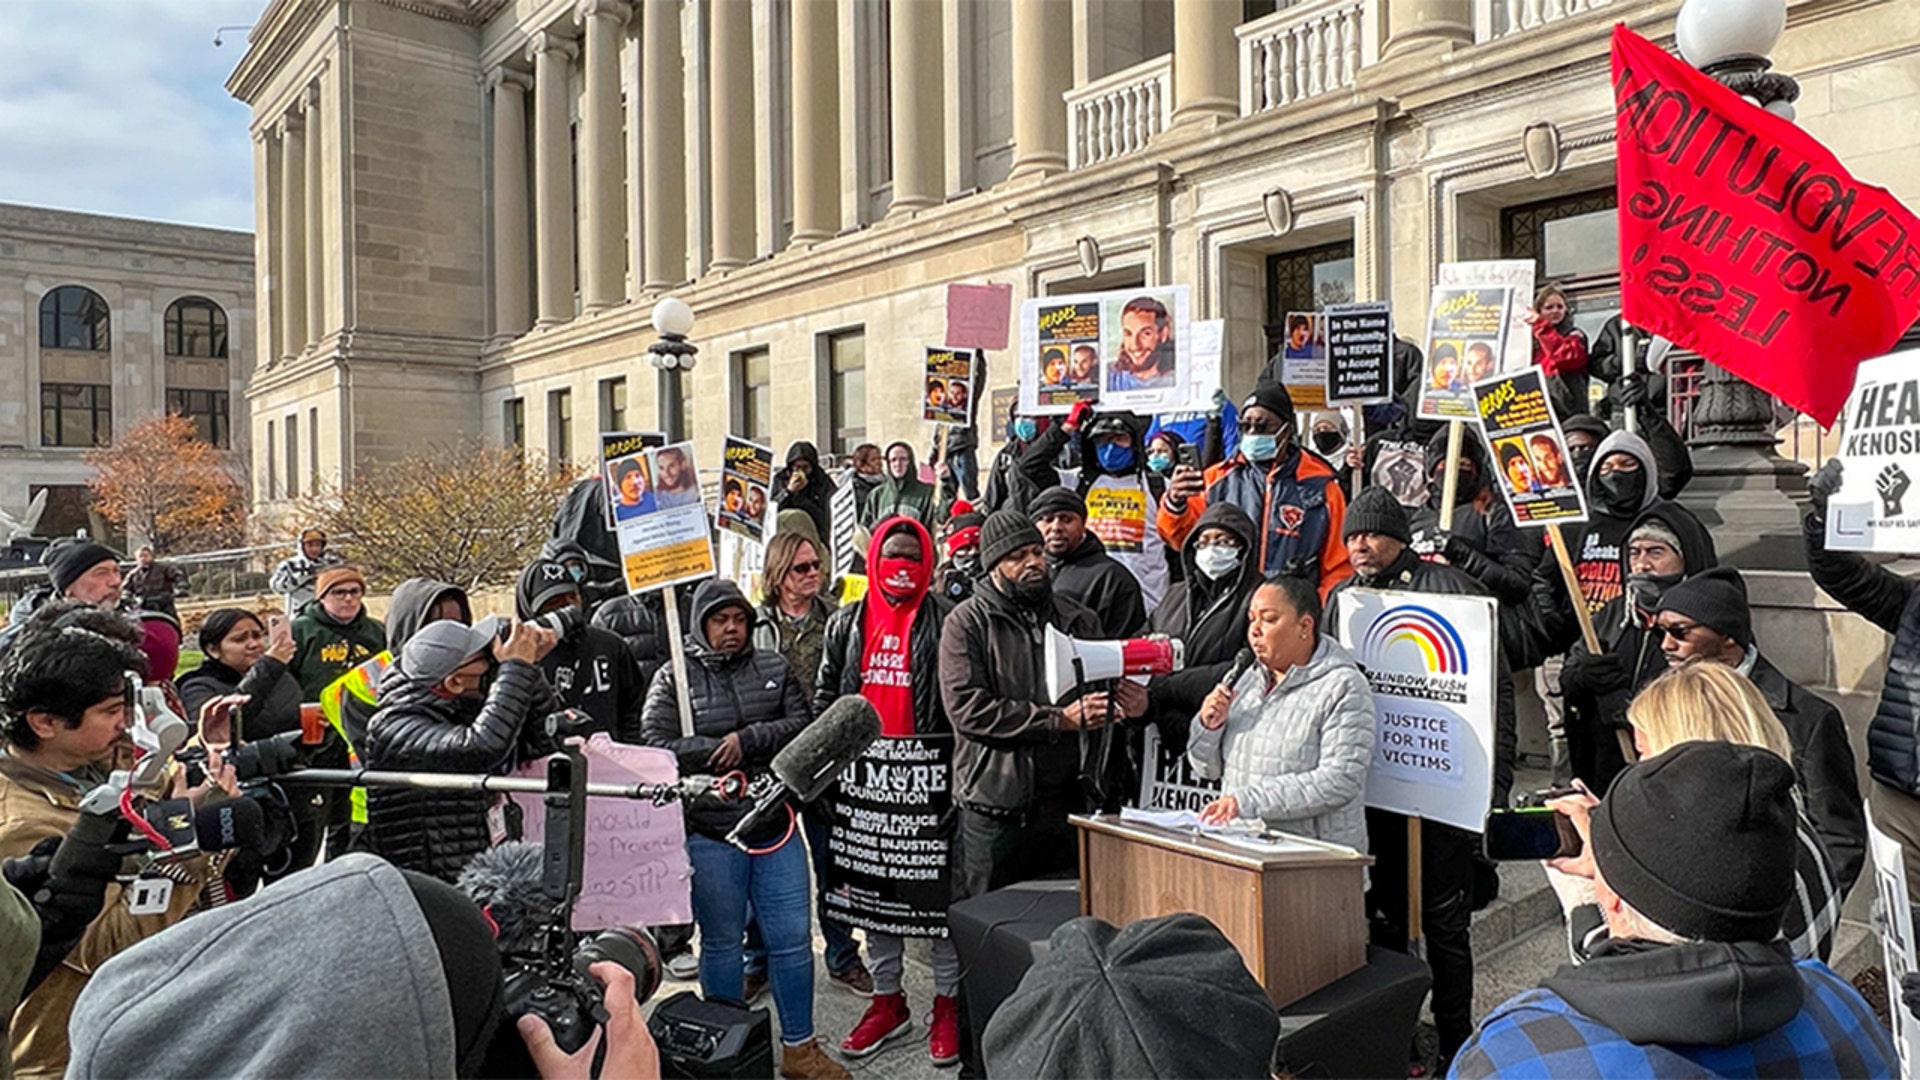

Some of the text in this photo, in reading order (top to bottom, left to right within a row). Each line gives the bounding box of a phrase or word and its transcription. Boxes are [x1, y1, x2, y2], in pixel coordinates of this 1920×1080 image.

[1039, 304, 1076, 330] HEROES
[1342, 320, 1358, 329] the
[1359, 318, 1386, 328] Name
[1331, 333, 1341, 344] of
[1333, 343, 1384, 356] We REFUSE
[1348, 357, 1380, 369] Accept
[1346, 370, 1379, 381] Fascist
[1480, 378, 1516, 419] HEROES
[1105, 500, 1140, 510] NEVER
[881, 634, 900, 650] NO
[1429, 678, 1467, 692] PUSH
[1383, 712, 1448, 733] JUSTICE
[897, 740, 912, 750] AT
[914, 740, 924, 750] A
[1382, 730, 1450, 753] FOR THE
[863, 748, 940, 761] ORE MOMENT
[1381, 749, 1452, 773] VICTIMS
[840, 782, 929, 805] FOUNDATION
[836, 803, 938, 826] NO MORE POLICE
[850, 818, 920, 836] BRUTALITY
[845, 831, 878, 848] MORE
[880, 838, 948, 851] INJUSTICE
[829, 839, 947, 866] NO MORE VIOLENCE
[834, 856, 939, 880] NO MORE RACISM
[826, 909, 949, 938] nomorefoundation.org
